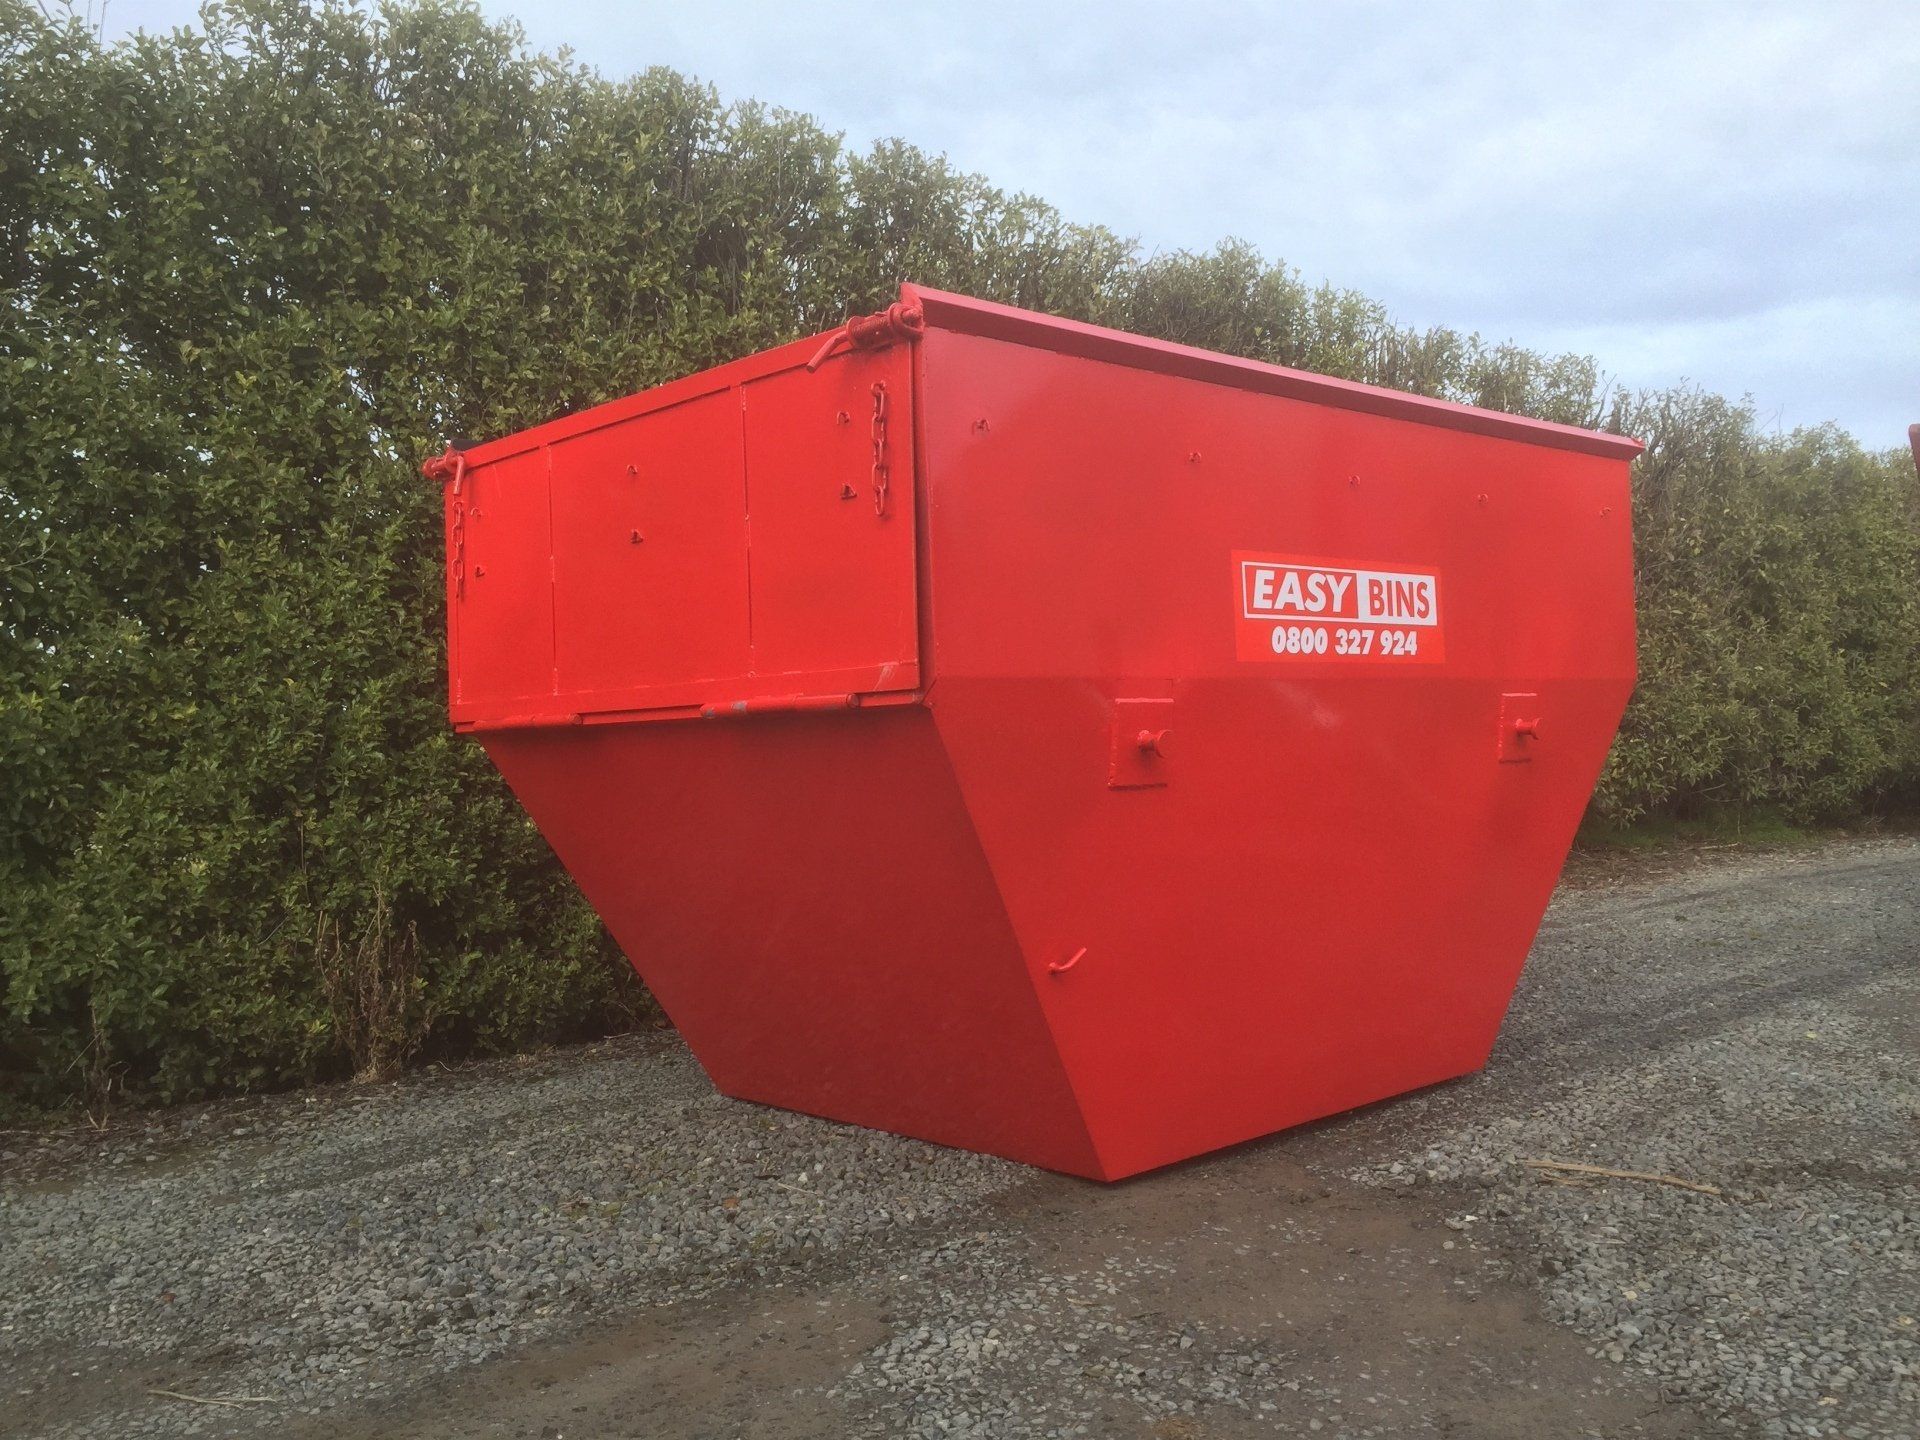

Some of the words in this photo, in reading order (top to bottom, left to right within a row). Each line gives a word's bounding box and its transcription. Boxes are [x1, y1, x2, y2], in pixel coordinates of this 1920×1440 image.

[1253, 569, 1352, 613] EASY
[1368, 578, 1430, 619] BINS
[1271, 625, 1329, 655] 0800
[1335, 628, 1375, 655] 327
[1380, 629, 1418, 656] 924
